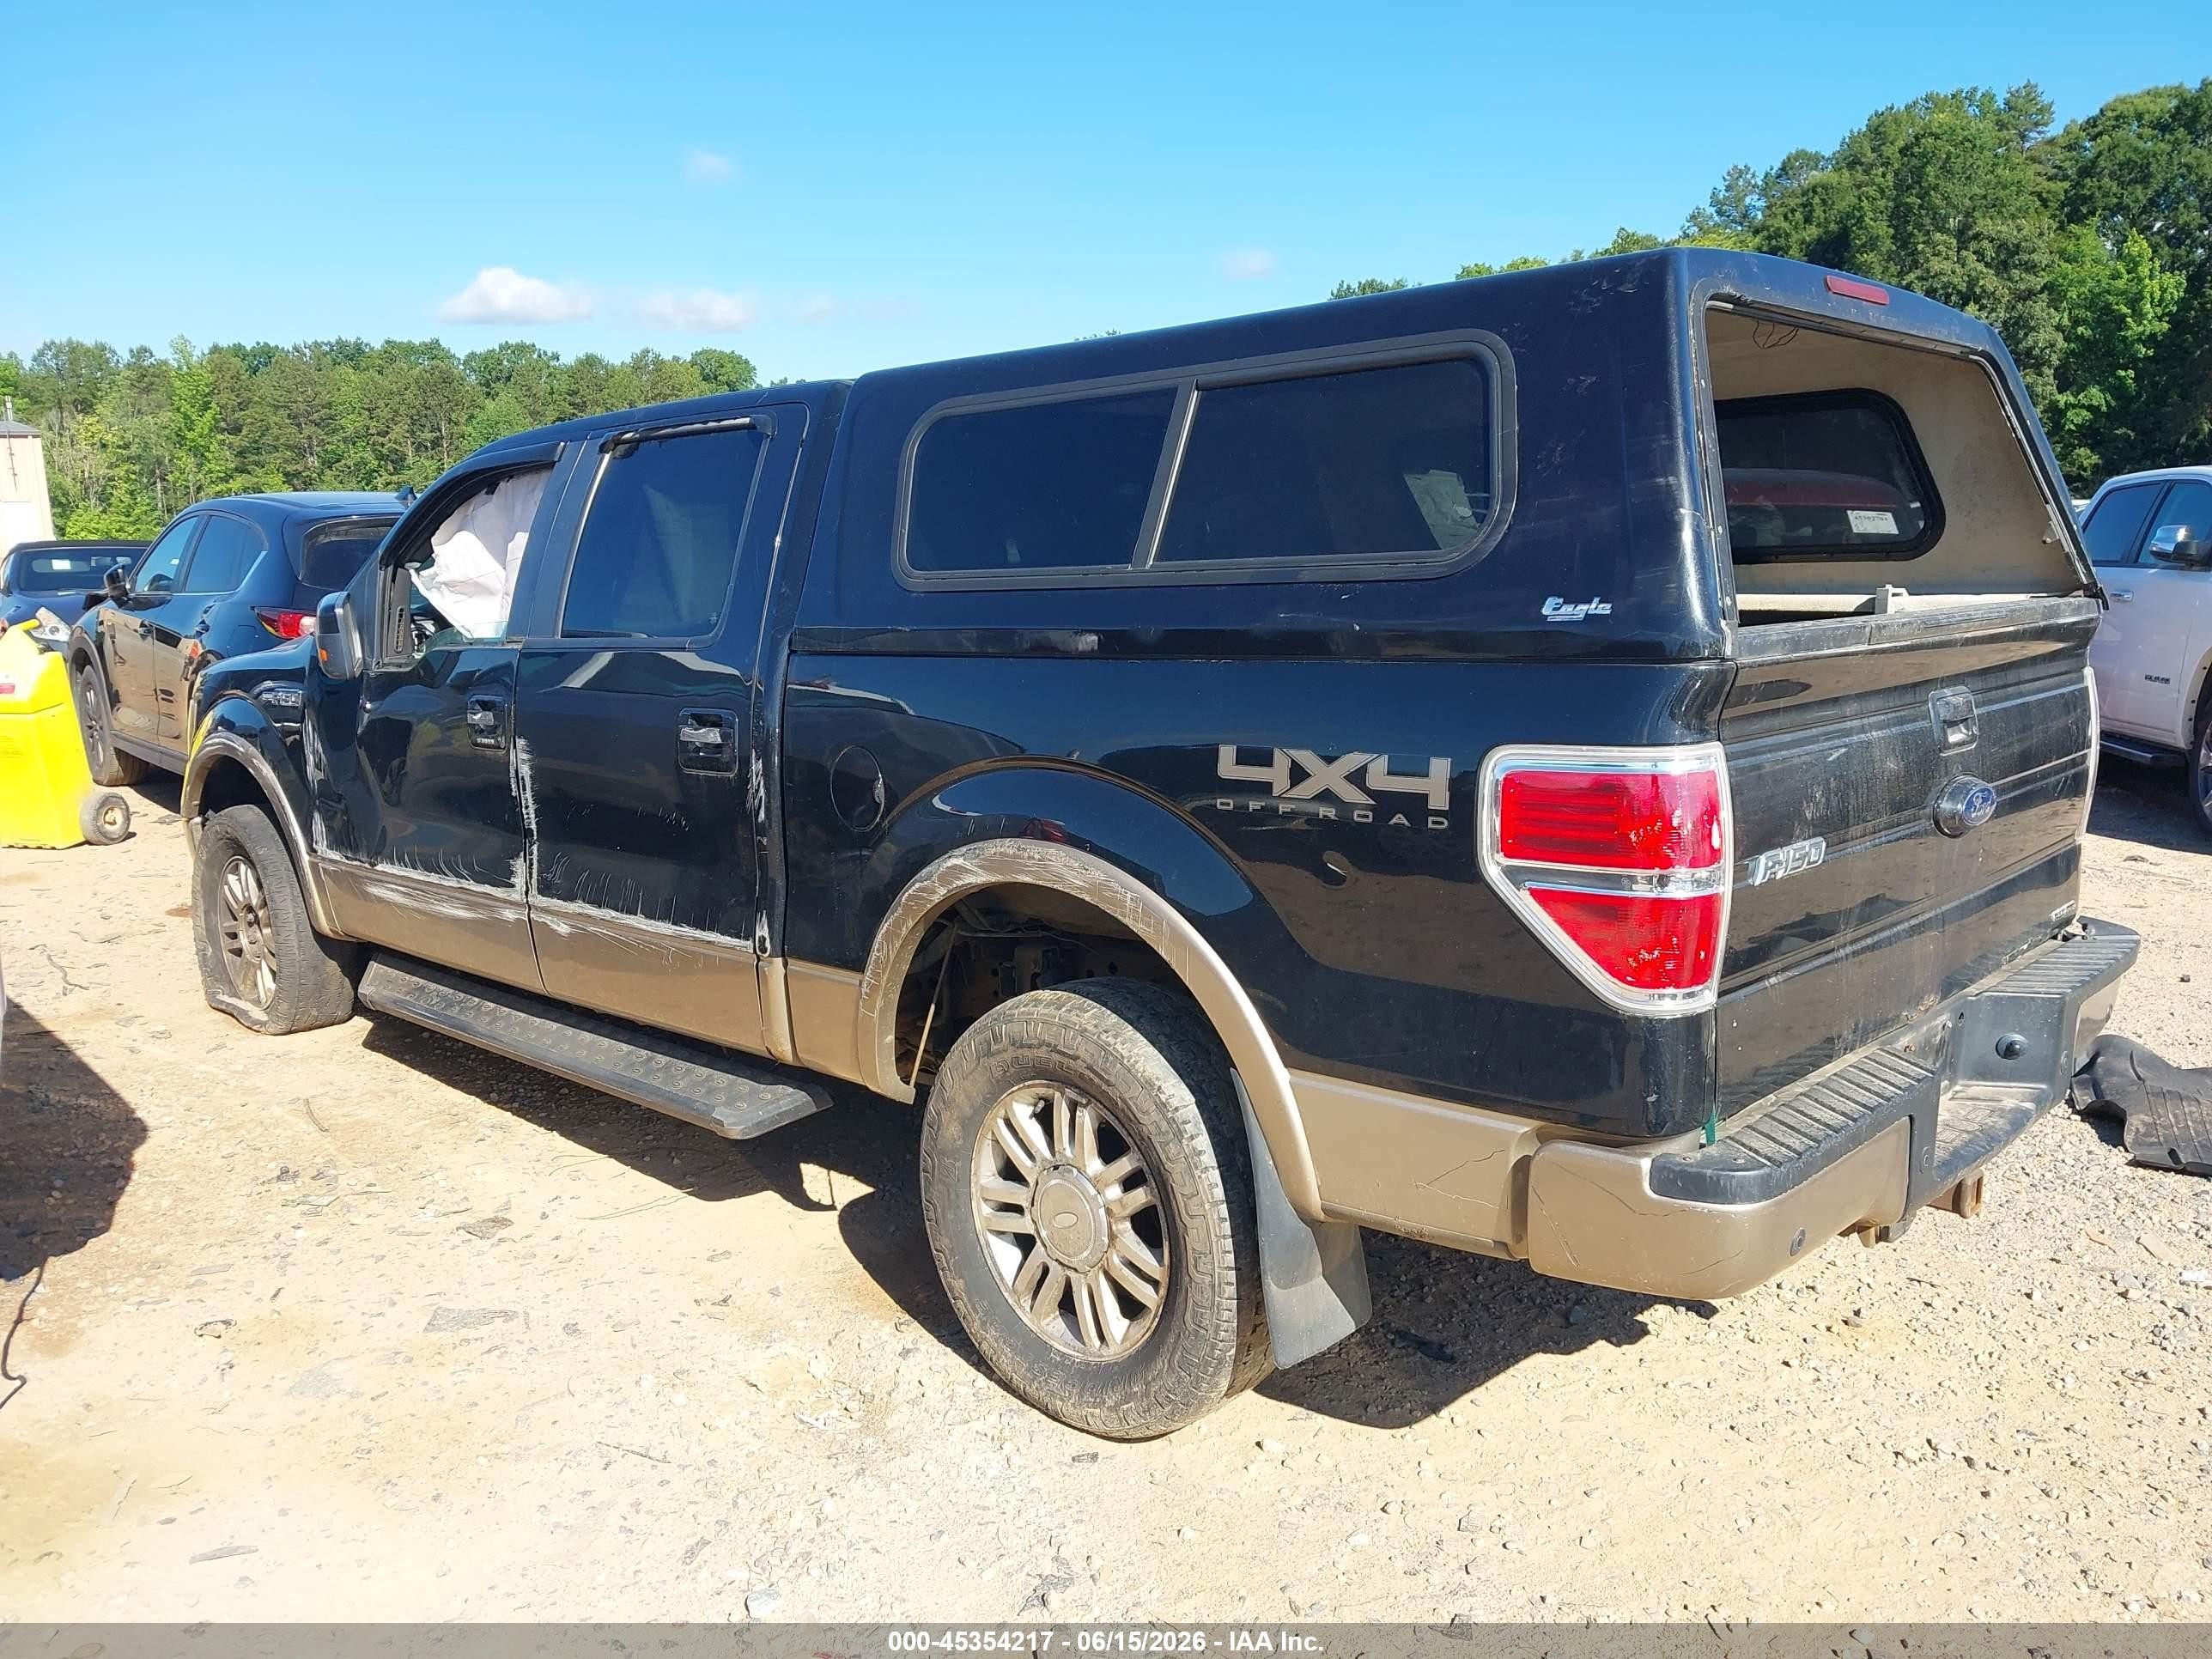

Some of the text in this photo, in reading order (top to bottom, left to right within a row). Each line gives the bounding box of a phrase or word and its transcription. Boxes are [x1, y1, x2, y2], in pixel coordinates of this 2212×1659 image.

[1540, 596, 1613, 622] Eagle
[1218, 744, 1451, 810] 4X4
[1216, 798, 1449, 830] OFF ROAD
[1968, 789, 1994, 820] Ford
